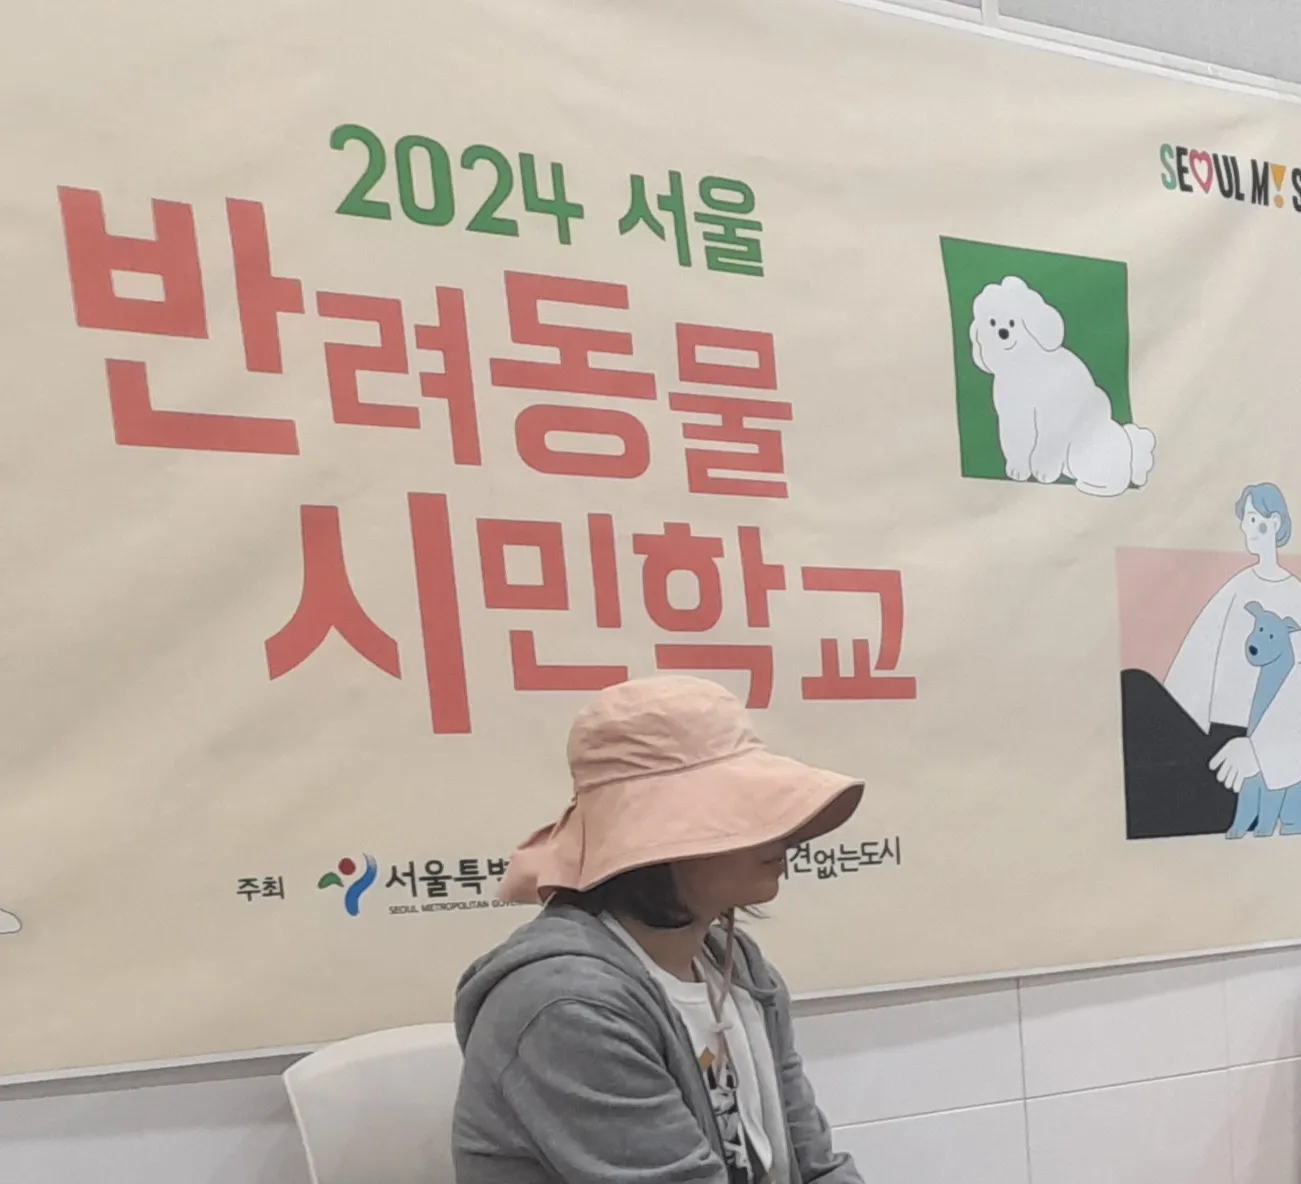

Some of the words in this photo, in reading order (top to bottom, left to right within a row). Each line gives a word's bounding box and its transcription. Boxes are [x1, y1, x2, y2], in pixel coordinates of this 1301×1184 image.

[328, 123, 585, 247] 2024
[618, 169, 766, 277] 서울
[56, 184, 794, 499] 반려동물
[264, 491, 918, 735] 시민학교
[236, 876, 285, 902] 주최
[784, 836, 900, 880] 견없는도시
